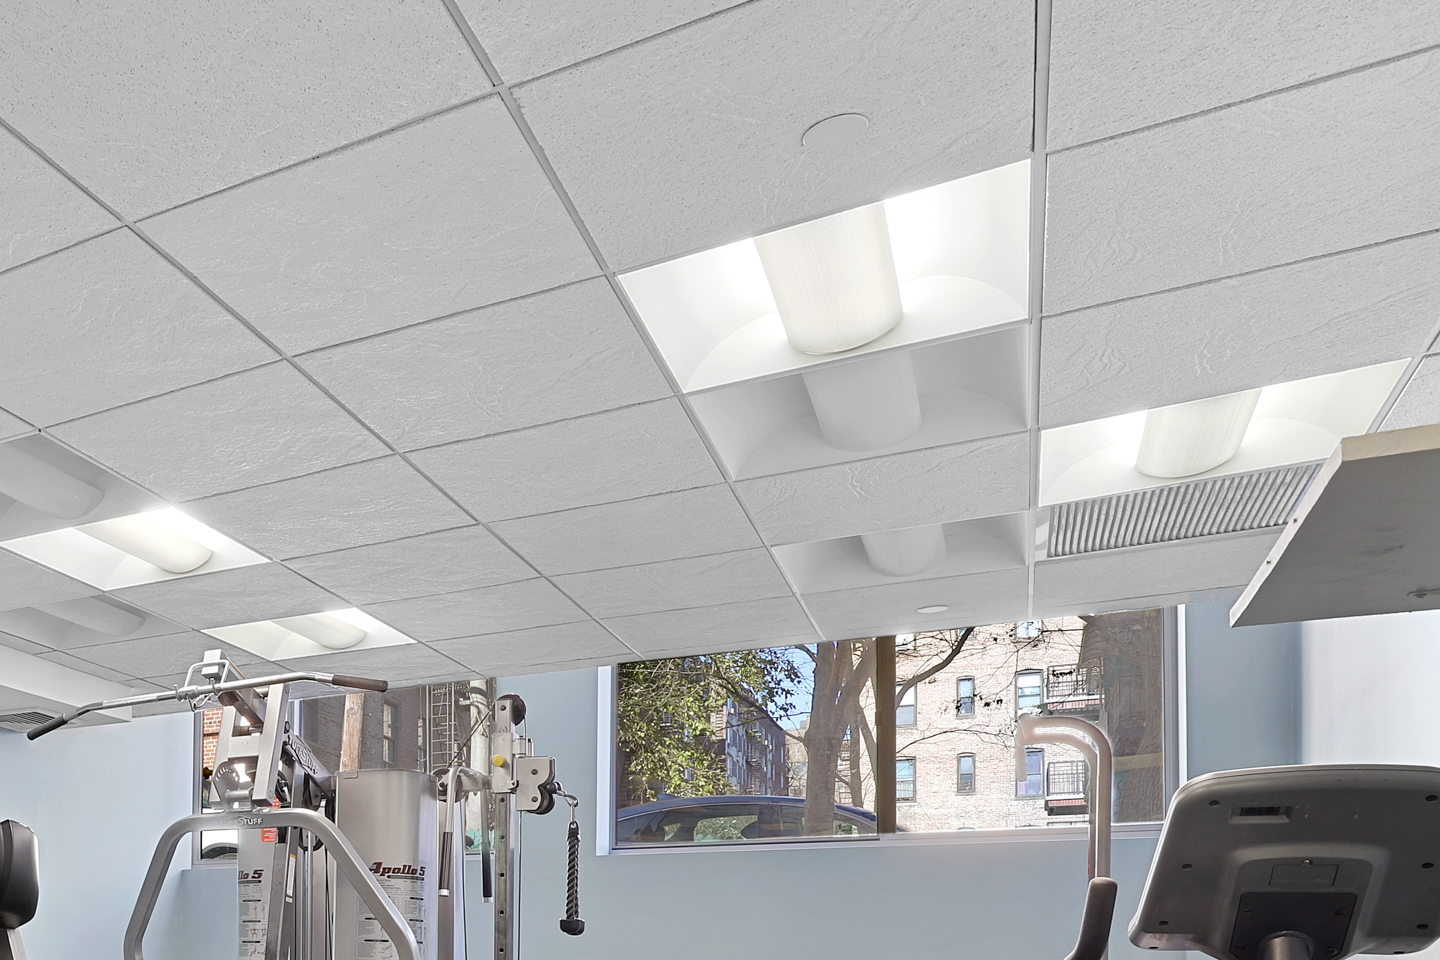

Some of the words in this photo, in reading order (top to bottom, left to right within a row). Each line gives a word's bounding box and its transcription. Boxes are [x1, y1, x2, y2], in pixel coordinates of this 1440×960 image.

[251, 869, 264, 880] 5
[369, 862, 418, 877] Apollo
[419, 866, 426, 877] 5
